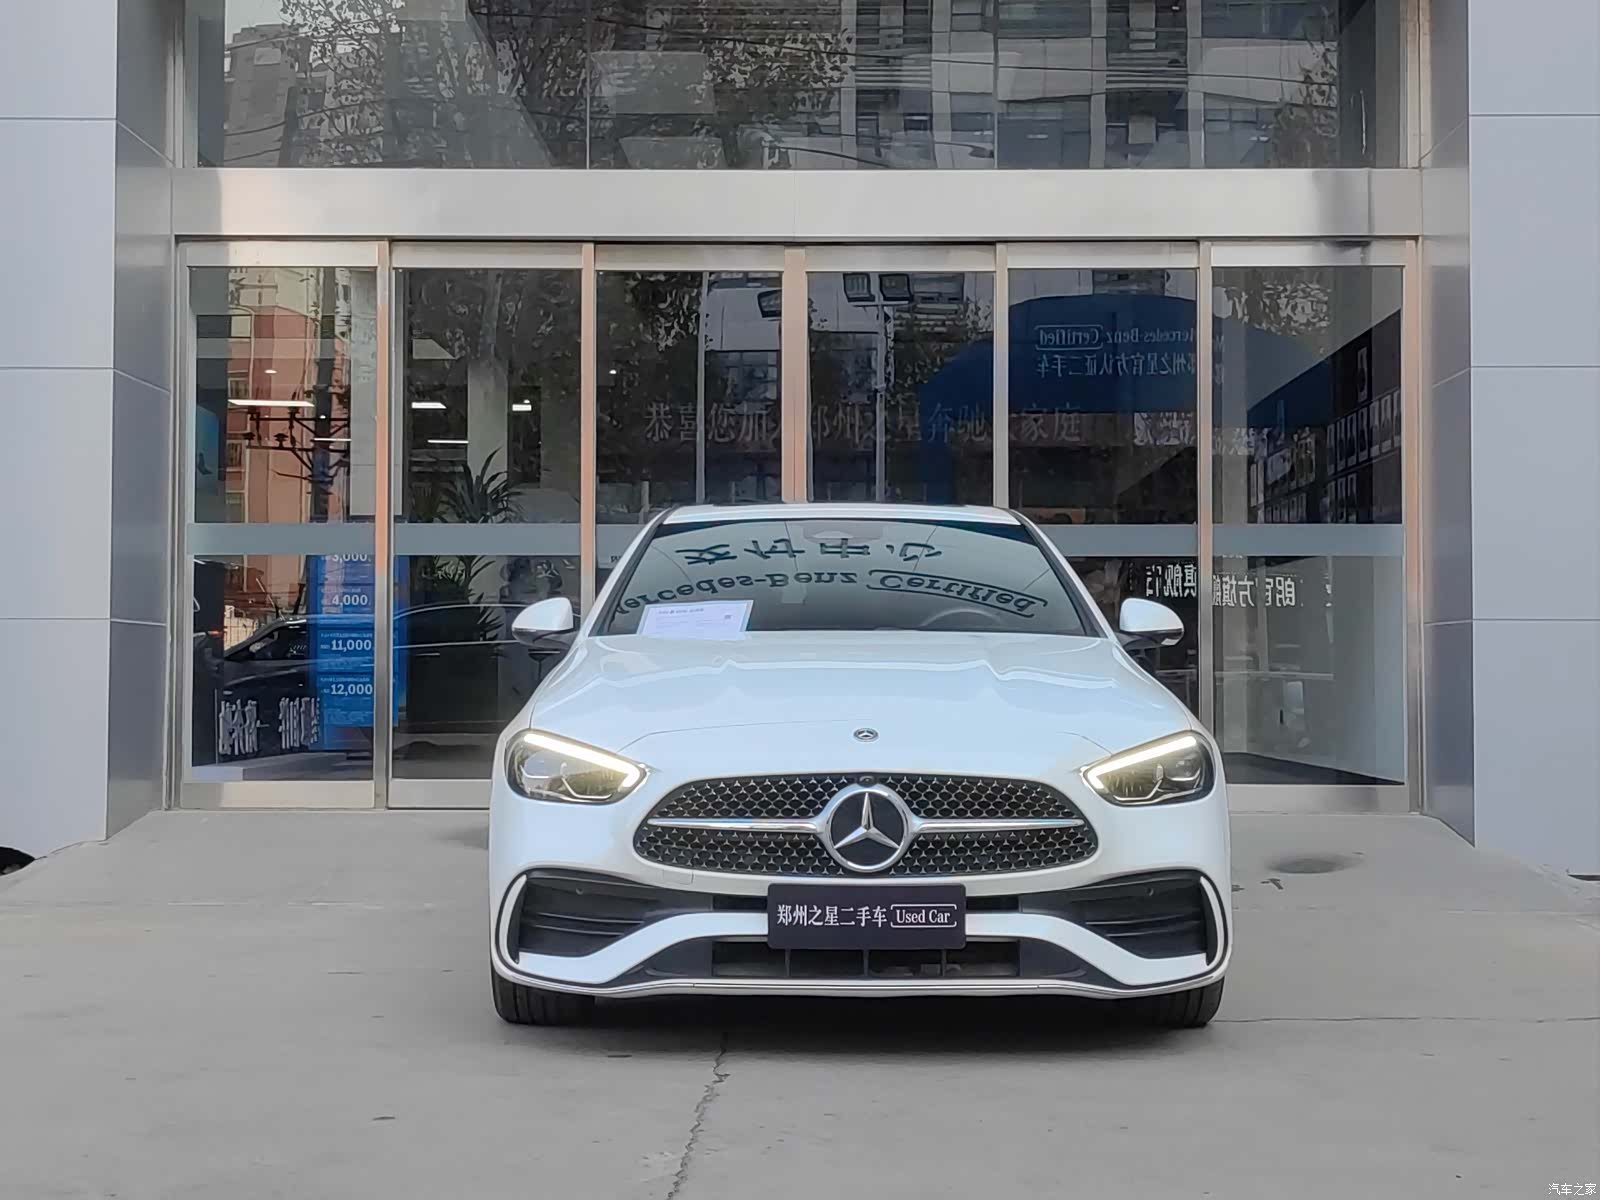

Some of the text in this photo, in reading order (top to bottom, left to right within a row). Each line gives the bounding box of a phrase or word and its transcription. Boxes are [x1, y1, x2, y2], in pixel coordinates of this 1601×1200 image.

[331, 594, 369, 607] 4,000
[331, 639, 373, 652] 11,000
[330, 683, 374, 697] 12,000
[776, 904, 951, 928] 郑州之星二手车 Used Car
